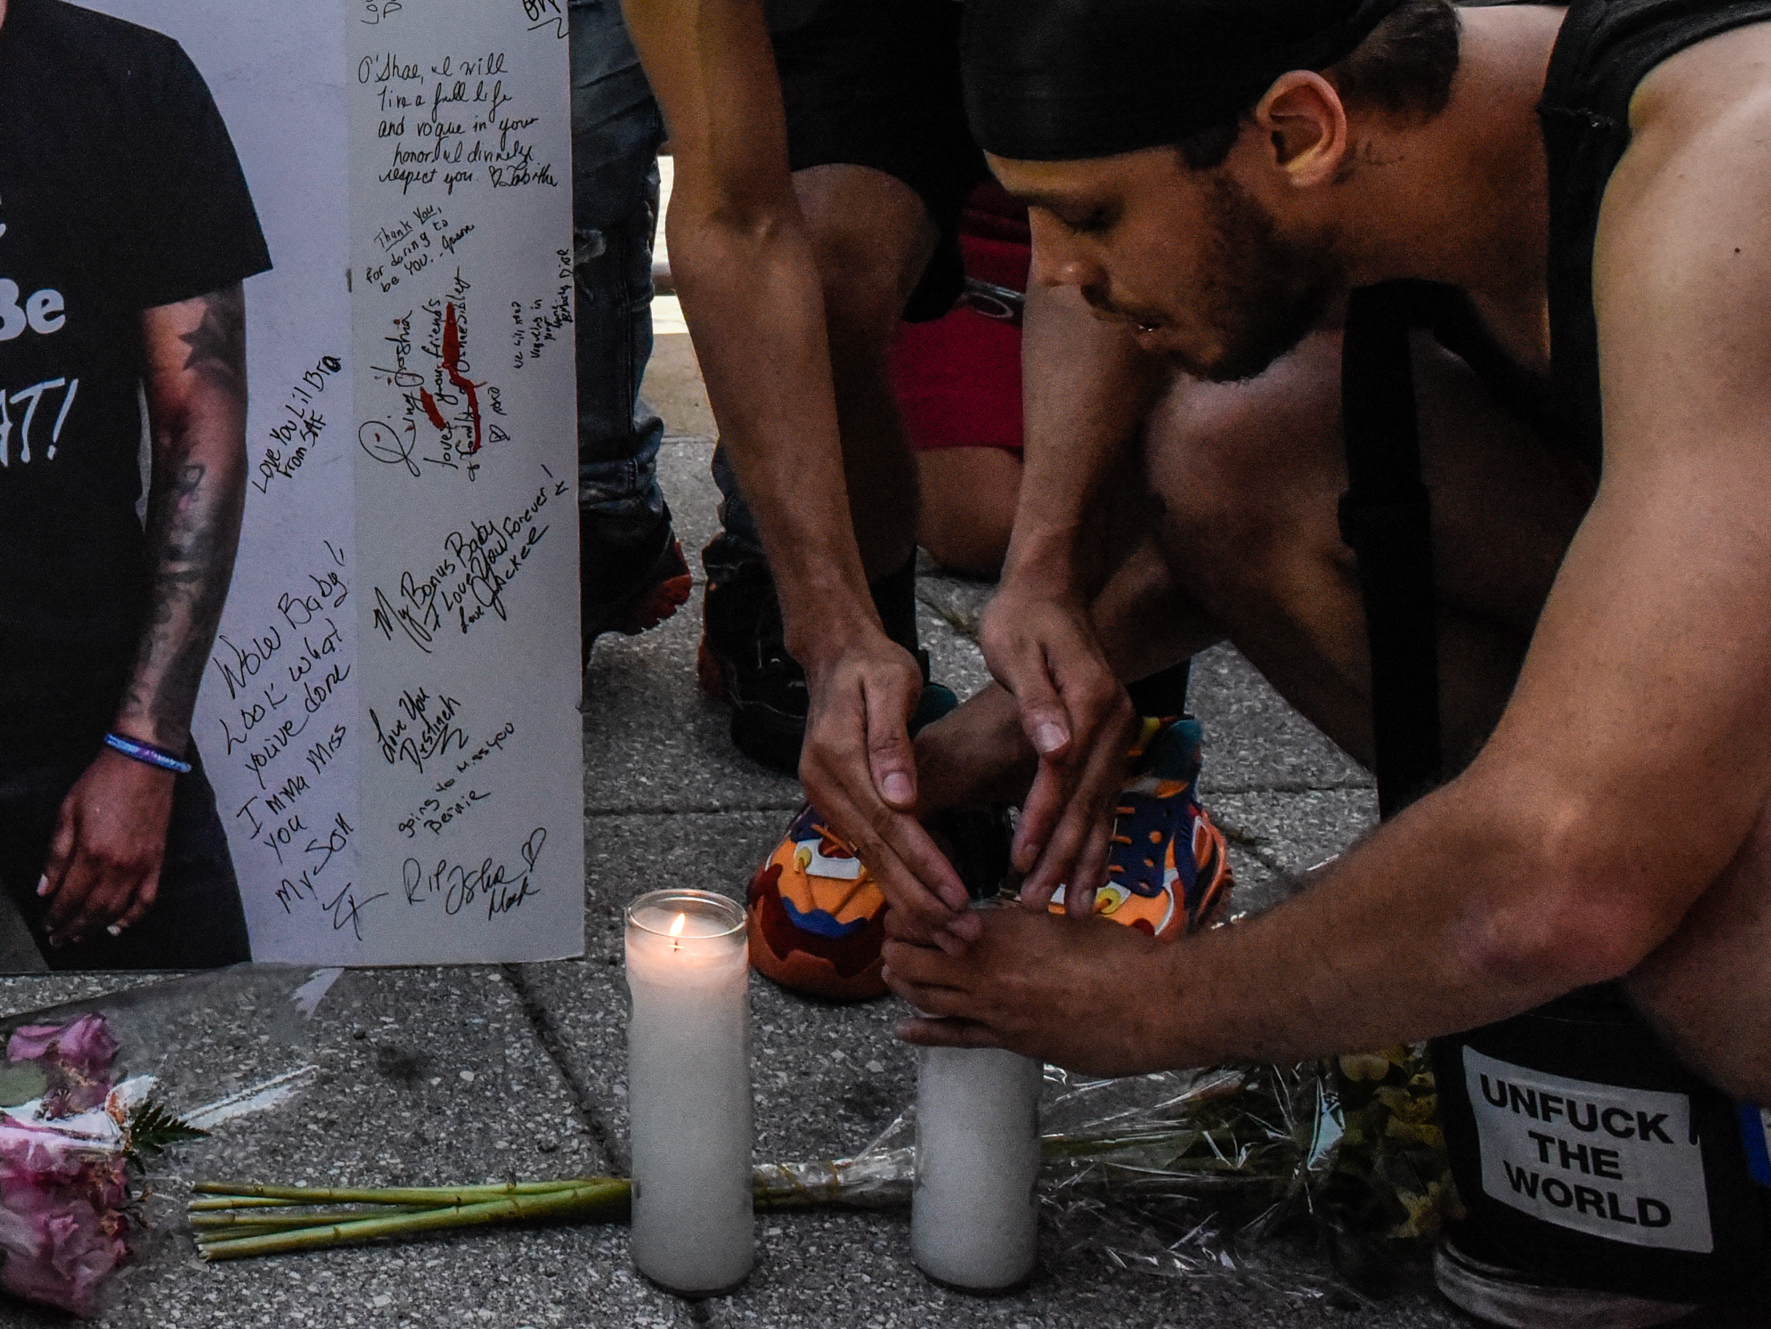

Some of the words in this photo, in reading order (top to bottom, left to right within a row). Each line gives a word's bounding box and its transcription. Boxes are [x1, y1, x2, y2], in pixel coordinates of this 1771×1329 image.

[460, 53, 508, 75] will
[377, 85, 411, 111] live
[416, 95, 425, 106] a
[431, 81, 469, 122] full
[473, 80, 512, 122] life
[378, 116, 405, 137] and
[418, 123, 465, 161] vogue
[473, 115, 488, 131] in
[499, 117, 539, 151] your
[379, 167, 437, 195] respect
[374, 220, 413, 250] Thank
[390, 232, 431, 267] daring
[381, 276, 399, 293] be
[401, 560, 455, 610] Bonus
[305, 663, 351, 714] done
[1480, 1074, 1674, 1145] UNFUCK
[1529, 1130, 1623, 1181] THE
[1503, 1159, 1672, 1228] WORLD
